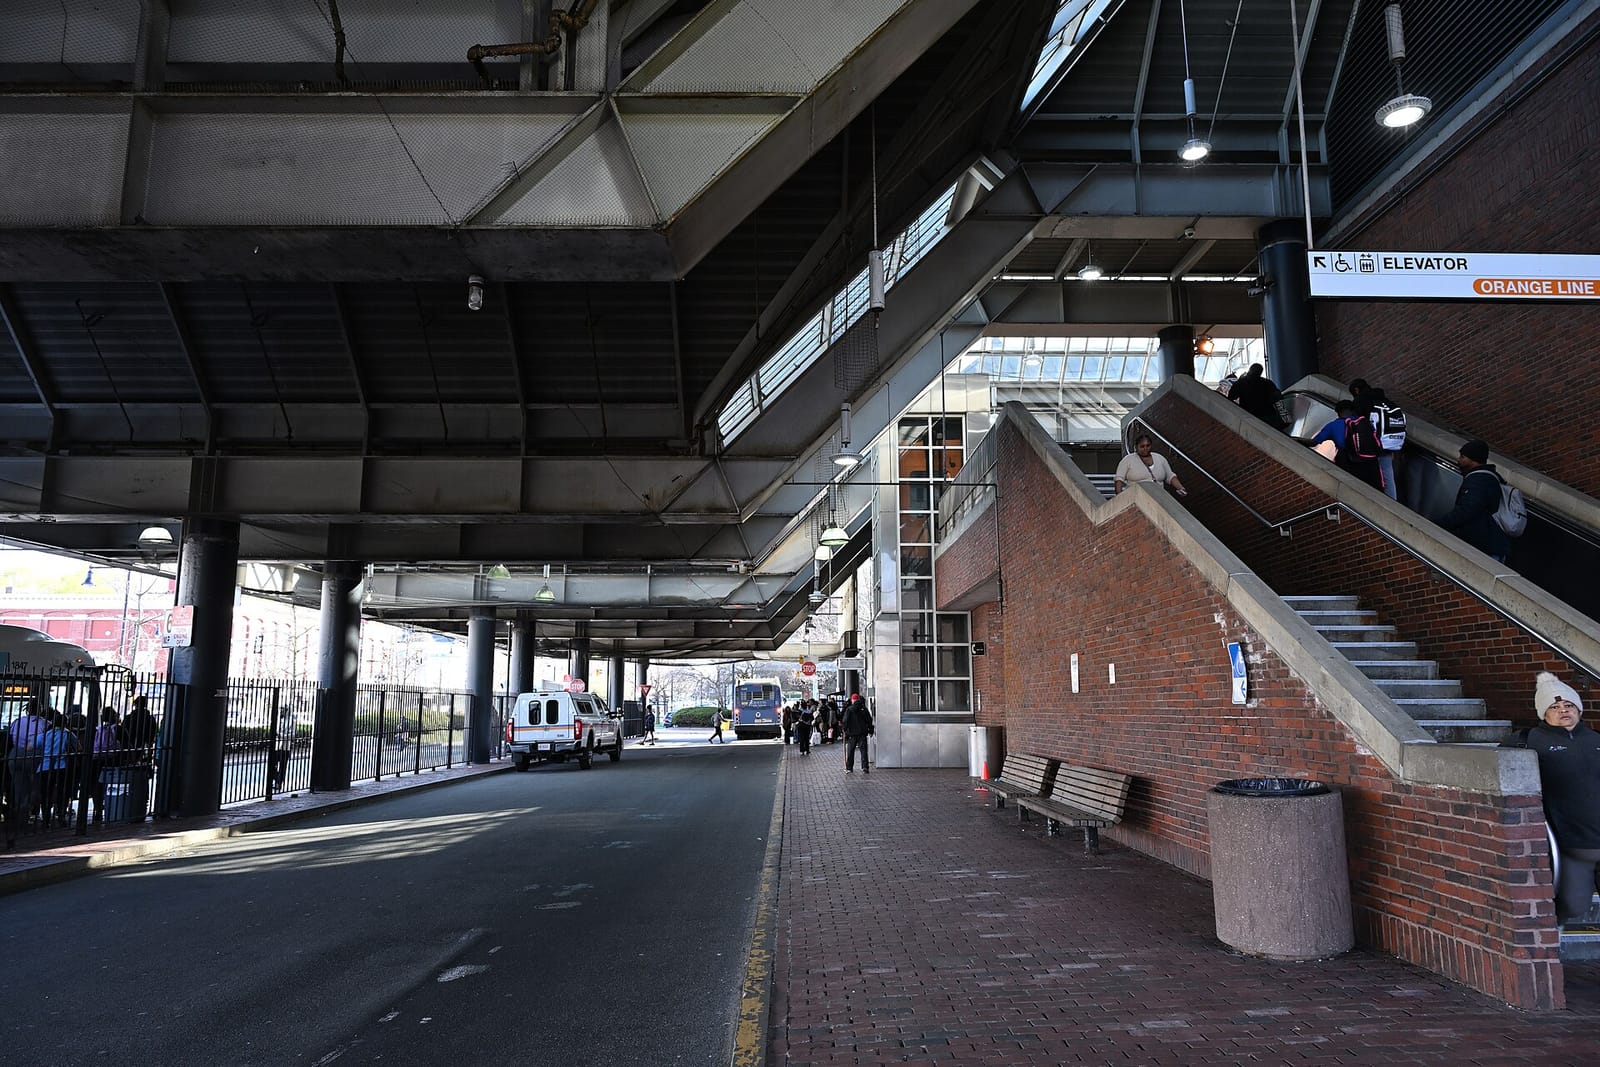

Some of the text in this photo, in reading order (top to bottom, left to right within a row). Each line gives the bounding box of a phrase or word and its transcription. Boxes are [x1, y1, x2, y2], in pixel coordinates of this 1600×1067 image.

[1383, 257, 1468, 270] ELEVATOR
[1480, 280, 1595, 295] ORANGE LINE
